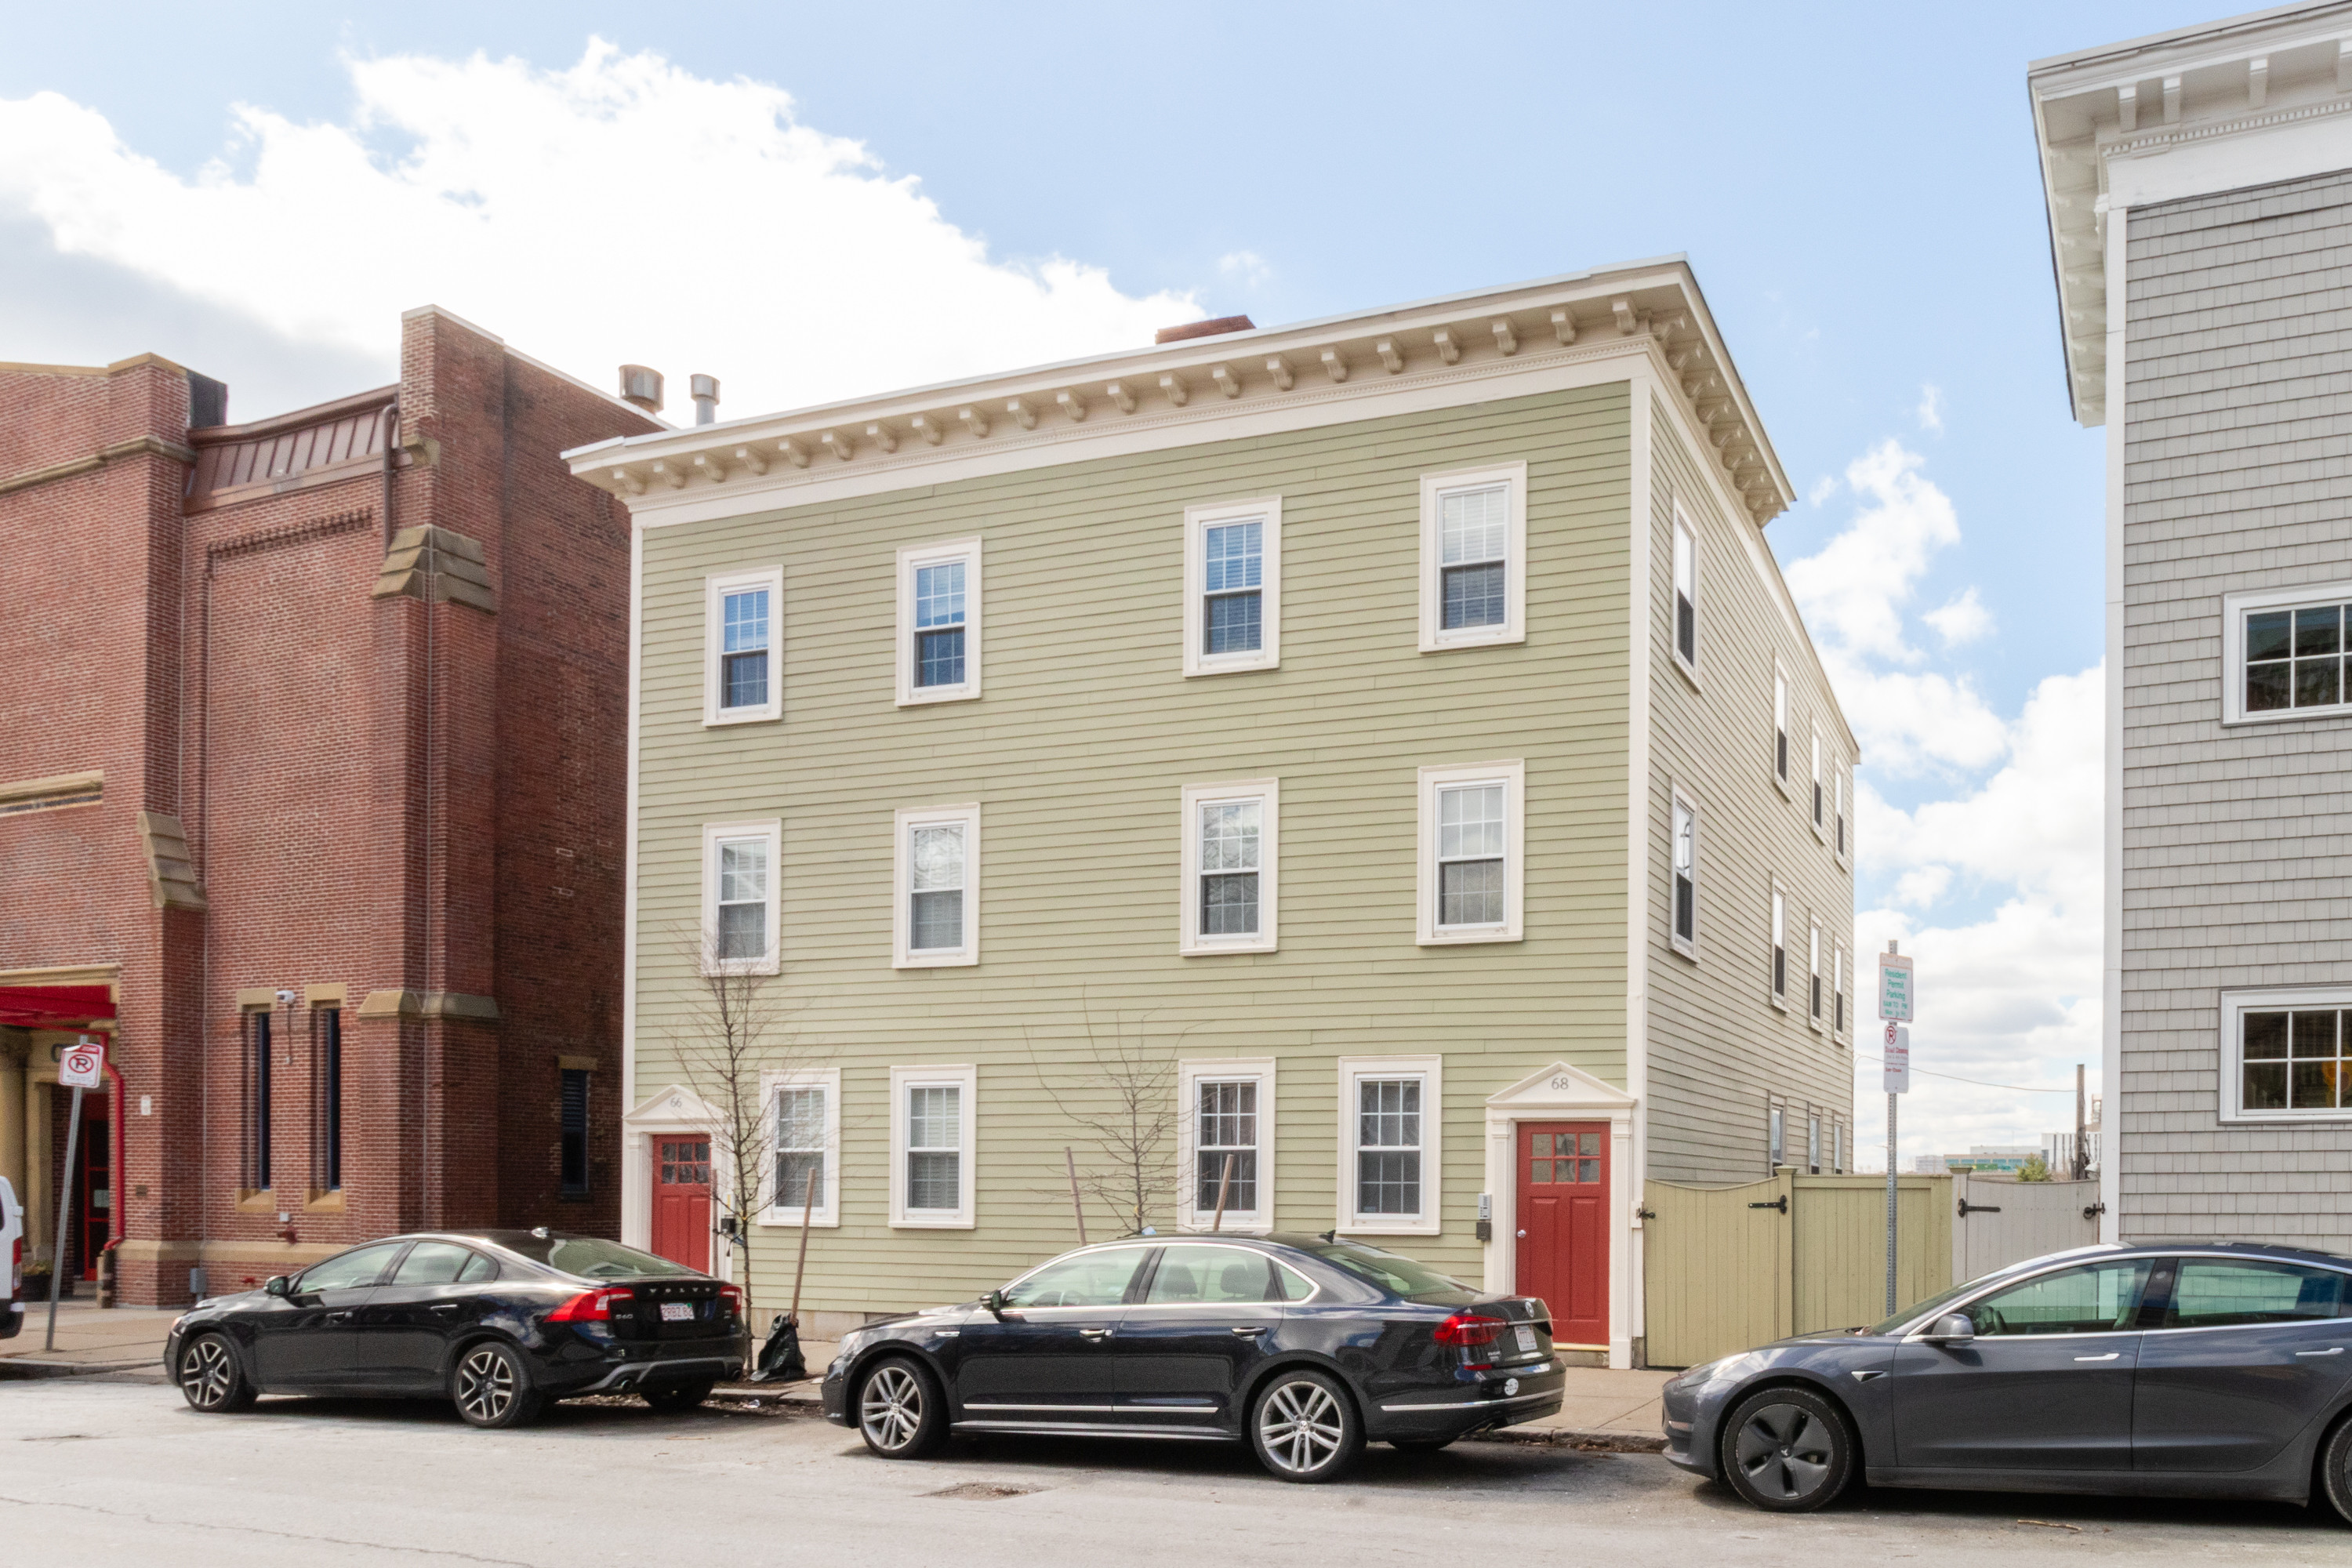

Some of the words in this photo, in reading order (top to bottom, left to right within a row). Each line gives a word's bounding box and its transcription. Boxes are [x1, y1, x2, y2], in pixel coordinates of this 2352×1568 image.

[1885, 968, 1907, 979] Resident
[1887, 978, 1904, 989] Permit
[1886, 989, 1906, 1002] Parking
[1552, 1077, 1569, 1090] 68
[670, 1097, 682, 1107] 66
